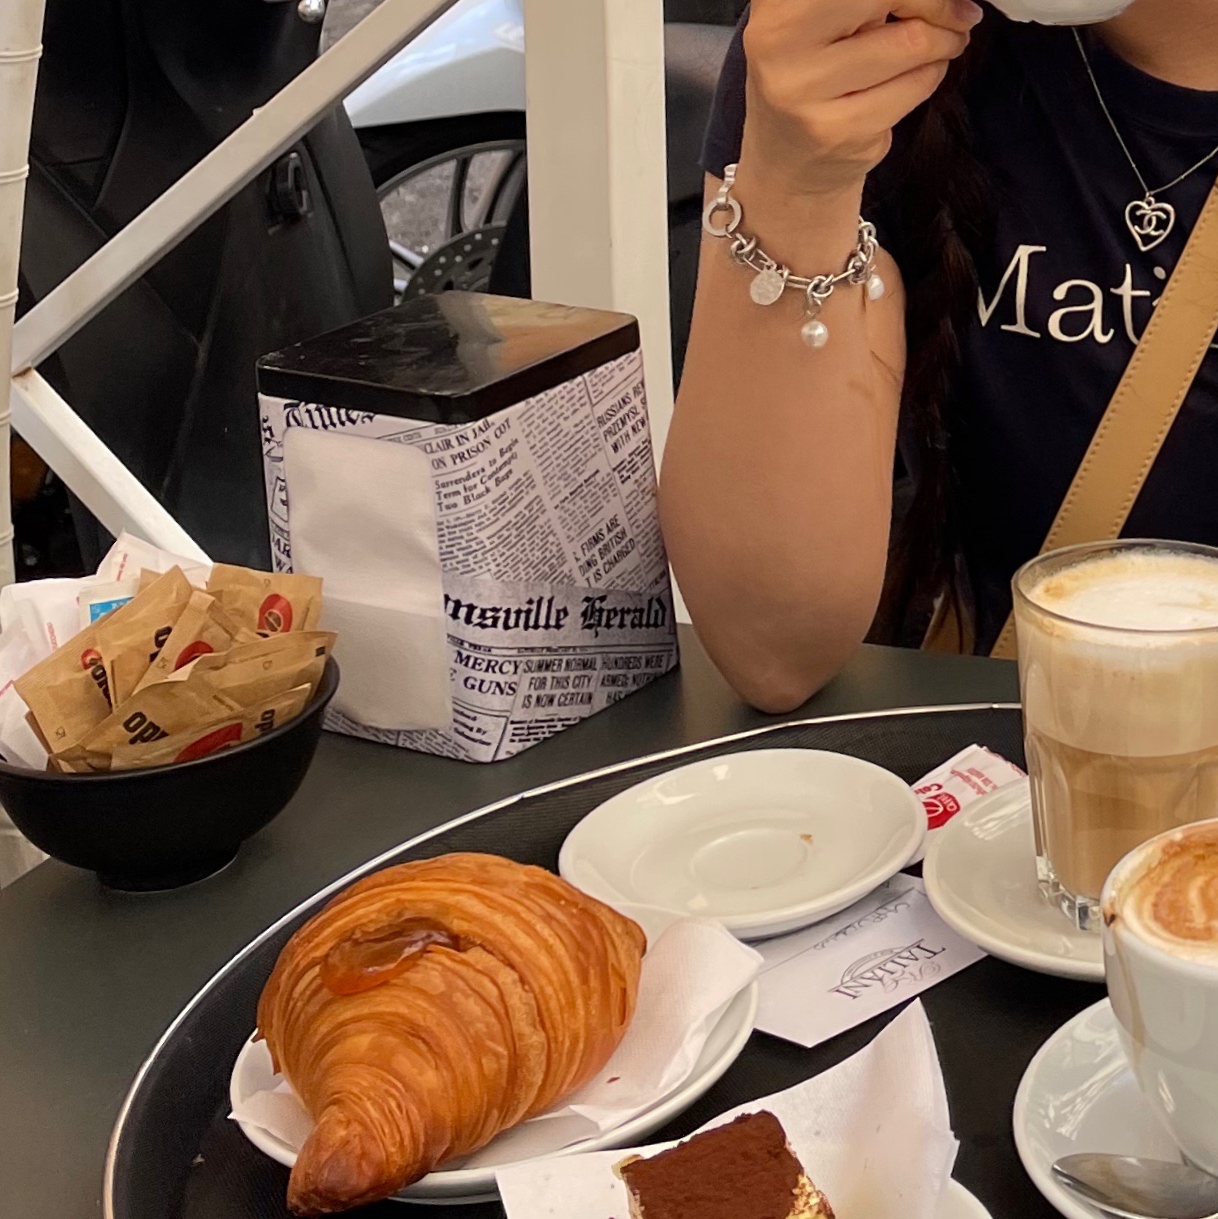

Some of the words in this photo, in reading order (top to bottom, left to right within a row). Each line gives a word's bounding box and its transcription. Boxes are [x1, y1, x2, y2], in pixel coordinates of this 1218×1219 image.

[455, 432, 470, 447] IN
[431, 456, 447, 470] ON
[450, 436, 492, 466] PRISON
[435, 467, 486, 490] Surrenders
[436, 490, 461, 500] Term
[436, 501, 458, 512] Two
[463, 485, 491, 505] Black
[581, 594, 667, 638] Herald
[454, 649, 523, 676] MERCY
[524, 657, 563, 674] SUMMER
[463, 675, 518, 696] GUNS
[528, 676, 547, 691] FOR
[550, 675, 570, 690] THIS
[571, 674, 594, 690] CITY
[522, 694, 533, 709] IS
[534, 693, 556, 708] NOW
[557, 691, 593, 707] CERTAIN
[835, 944, 947, 1001] TALIANI
